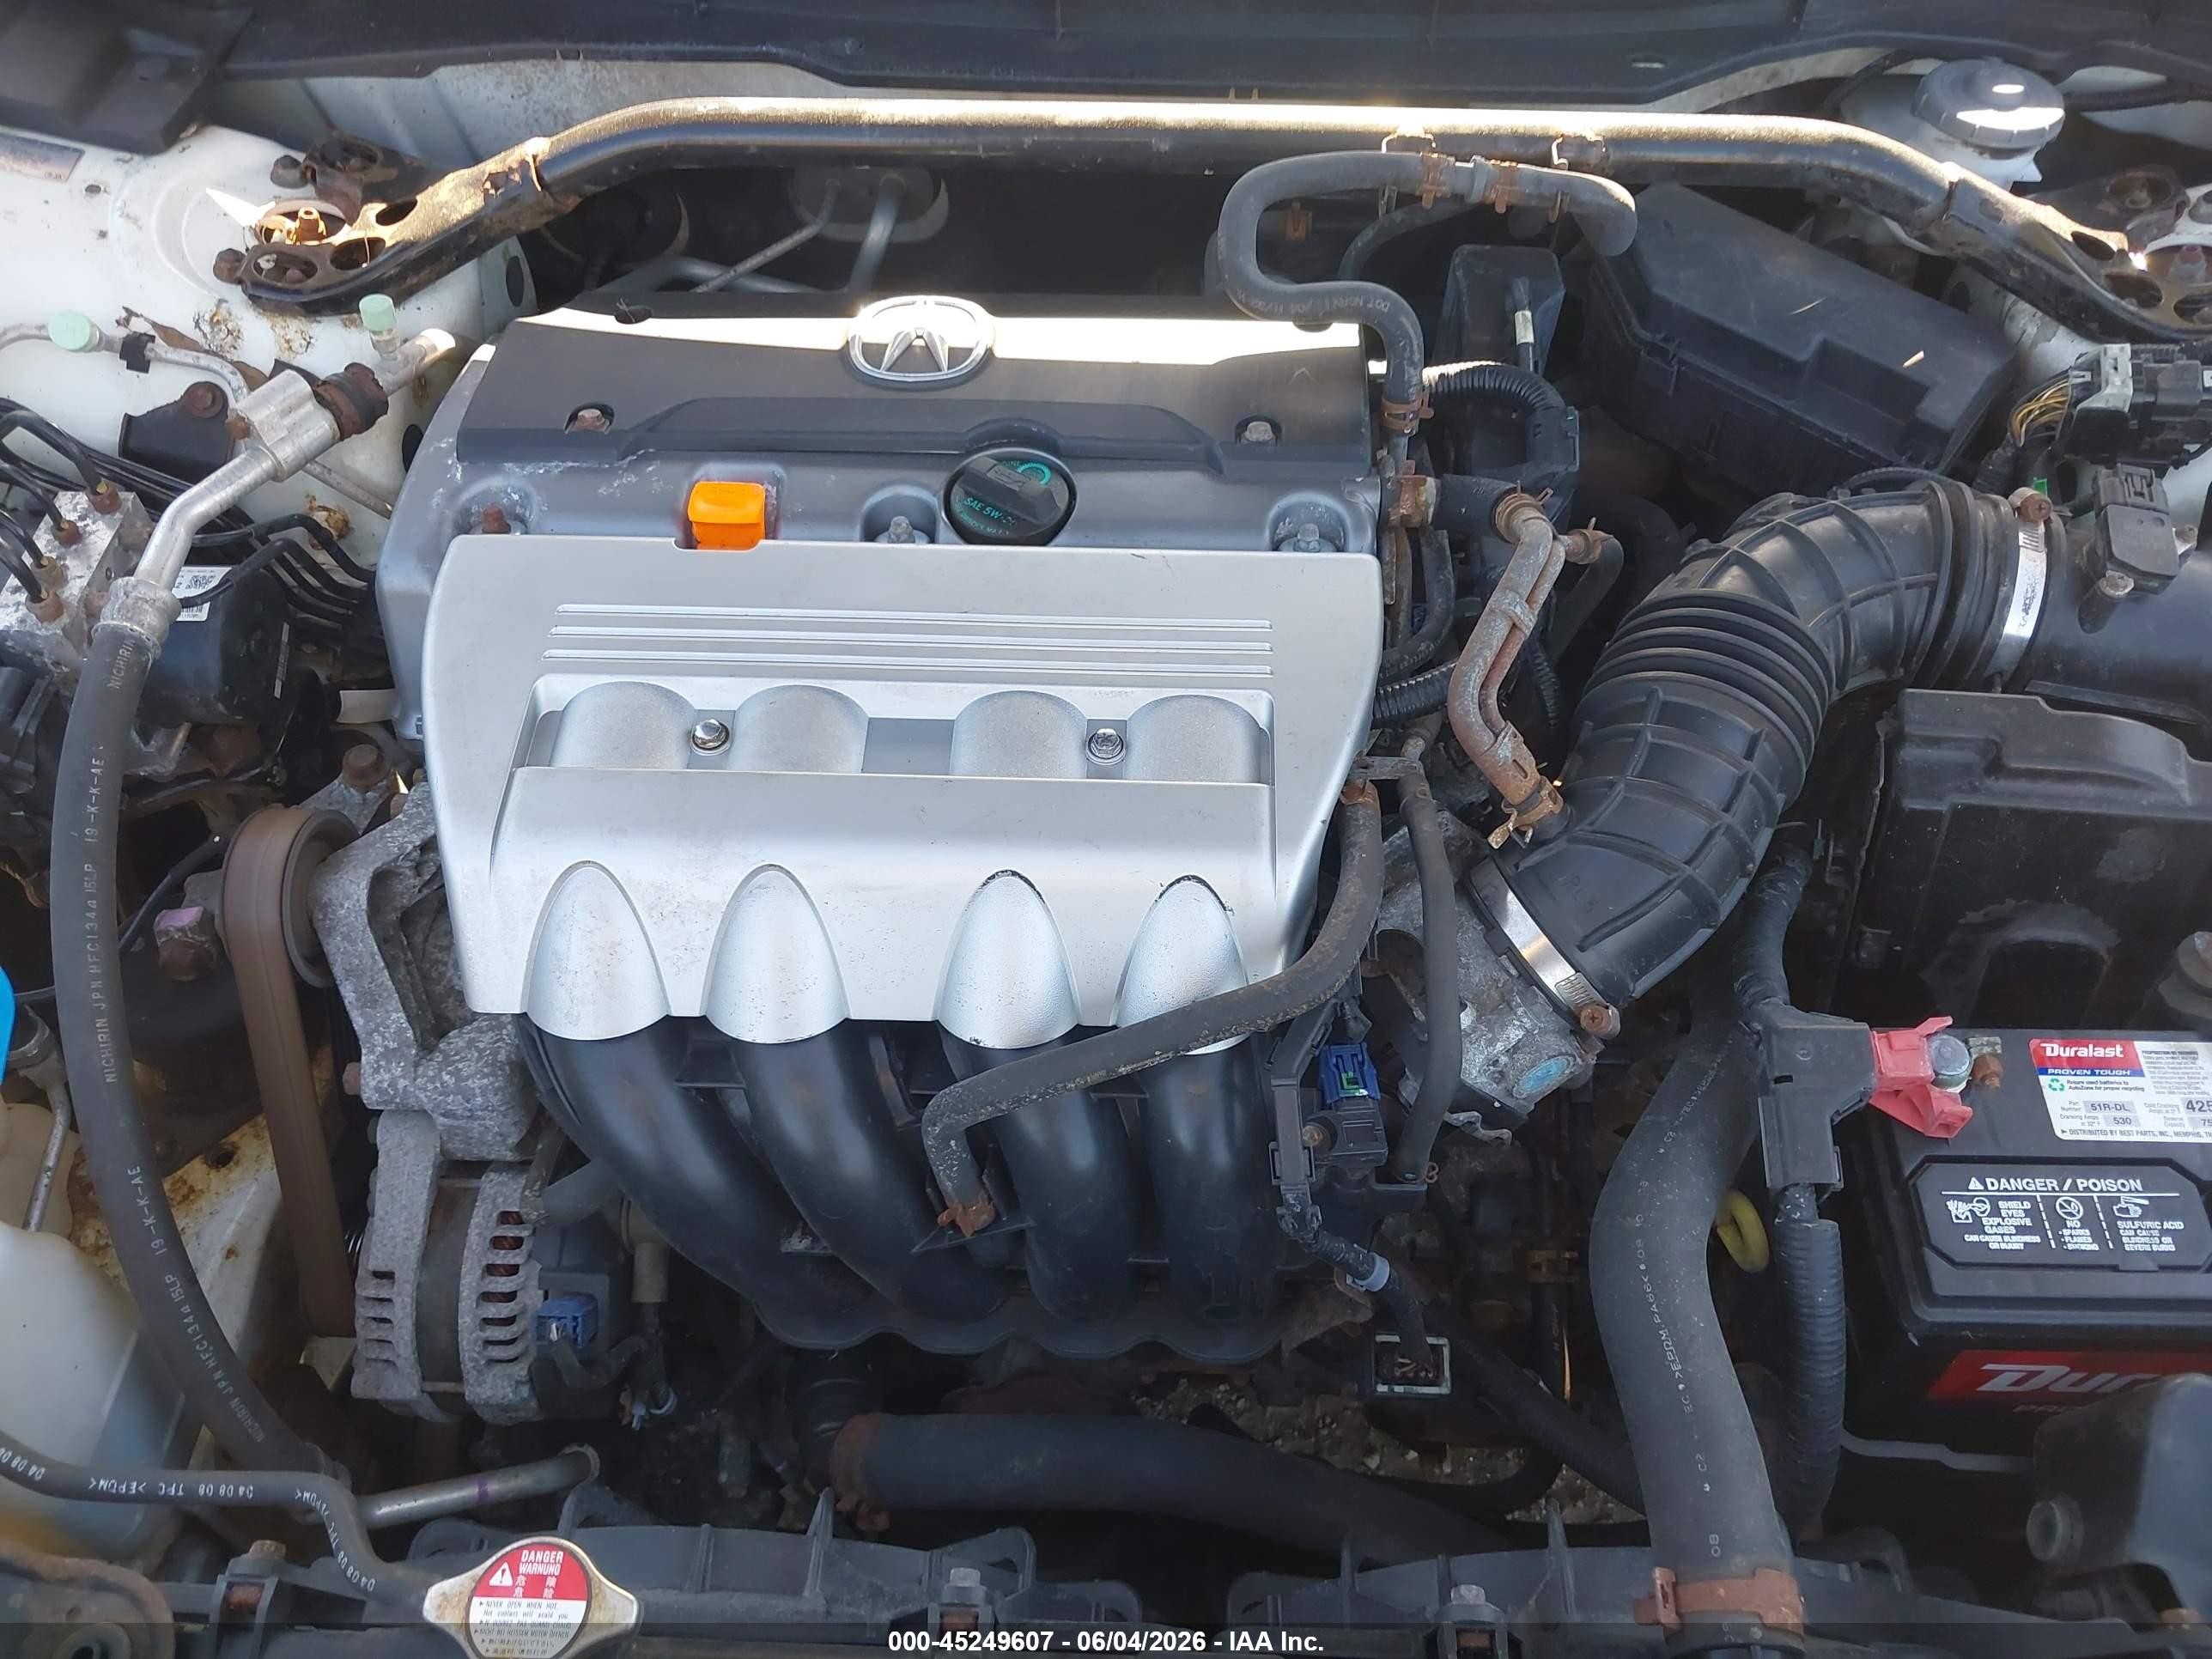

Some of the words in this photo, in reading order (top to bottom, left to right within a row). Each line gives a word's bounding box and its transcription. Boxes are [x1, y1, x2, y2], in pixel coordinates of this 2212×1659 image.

[964, 497, 984, 511] SAE
[91, 980, 106, 1011] JPN
[96, 1018, 118, 1084] NICHIRIN
[2040, 1042, 2124, 1058] Duralast
[2091, 1103, 2130, 1112] 51R-DL
[2113, 1117, 2132, 1126] 530
[1984, 1177, 2059, 1191] DANGER
[2063, 1178, 2072, 1191] /
[2076, 1179, 2143, 1192] POISON
[1998, 1200, 2031, 1209] SHIELD
[2000, 1209, 2025, 1218] EYES
[1982, 1218, 2033, 1226] EXPLOSIVE
[2163, 1221, 2185, 1230] ACID
[1984, 1225, 2016, 1234] GASES
[212, 1369, 234, 1395] JPN
[230, 1396, 265, 1443] NICHIRIN
[11, 1455, 28, 1473] 08
[27, 1466, 46, 1481] 04
[158, 1482, 184, 1497] TPC
[198, 1483, 213, 1497] 08
[219, 1484, 234, 1498] 08
[238, 1485, 254, 1498] 04
[337, 1551, 347, 1570] 08
[521, 1550, 564, 1564] DANGER
[345, 1566, 360, 1583] 08
[519, 1562, 562, 1576] WARNUNG
[361, 1577, 376, 1592] 04
[485, 1600, 503, 1608] NEVER
